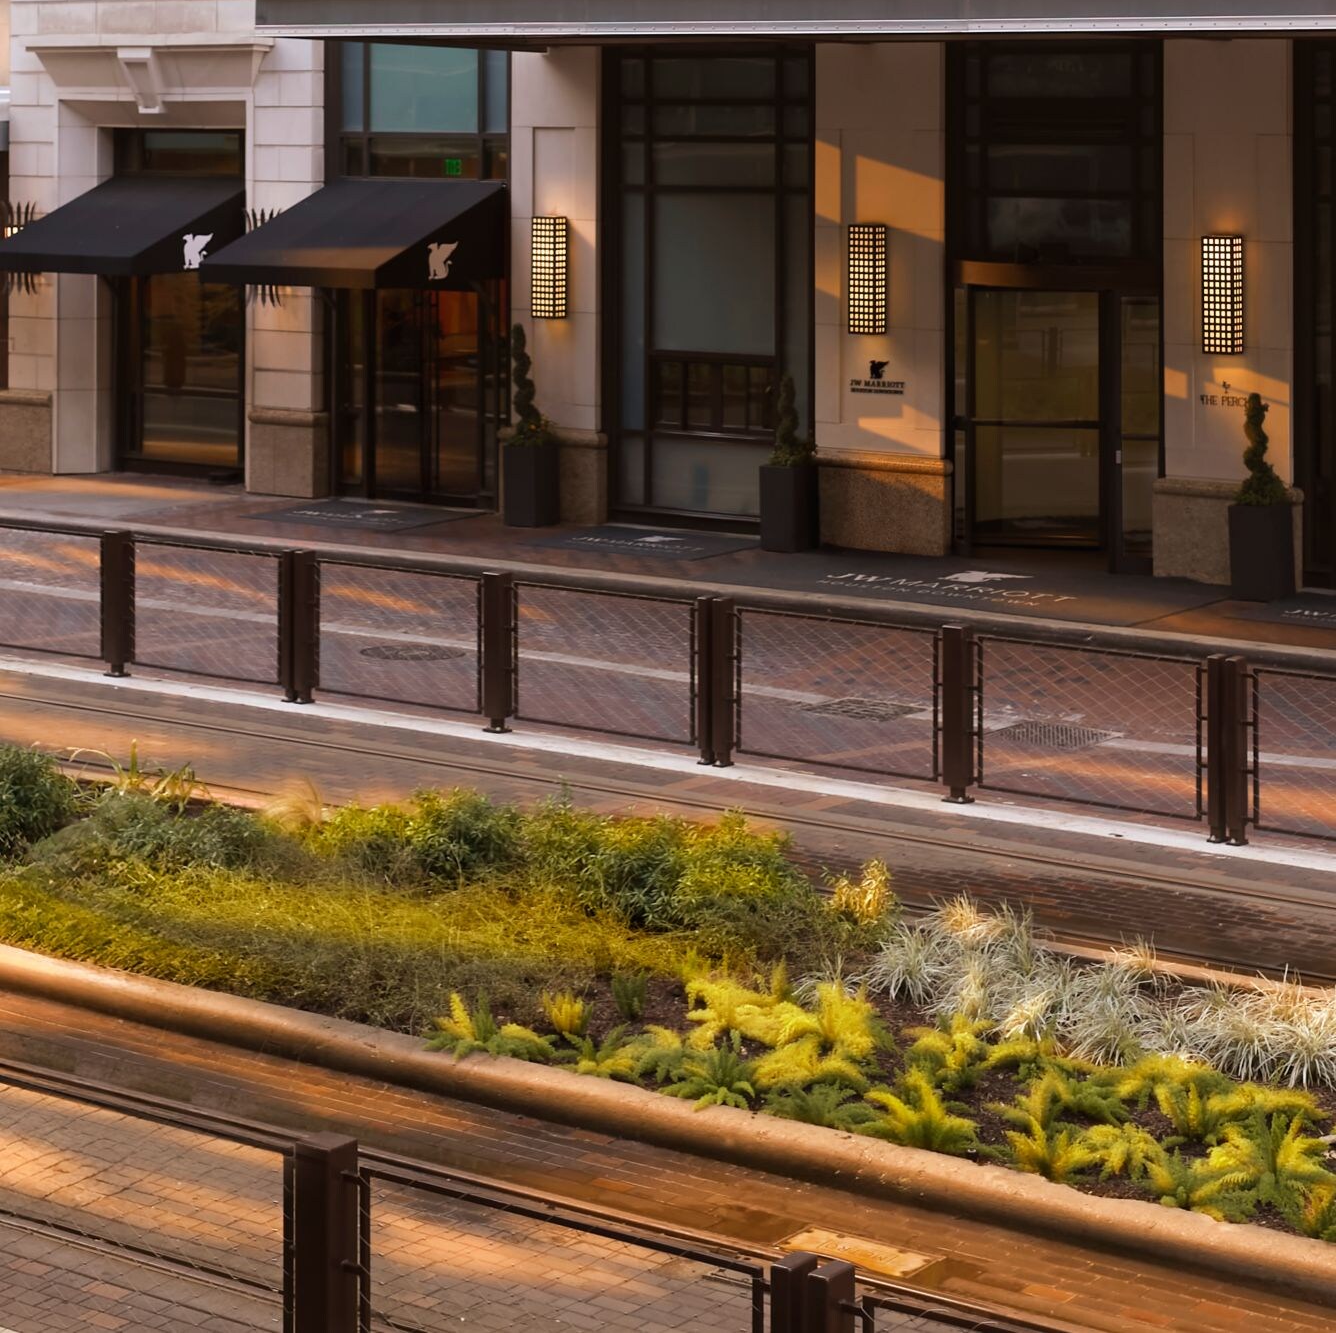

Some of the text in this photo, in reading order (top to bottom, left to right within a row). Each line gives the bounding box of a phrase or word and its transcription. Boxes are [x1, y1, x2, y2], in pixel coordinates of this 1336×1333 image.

[850, 379, 905, 389] JW MARRIOTT
[1200, 395, 1218, 406] THE
[826, 573, 1079, 603] JW MARRIOTT
